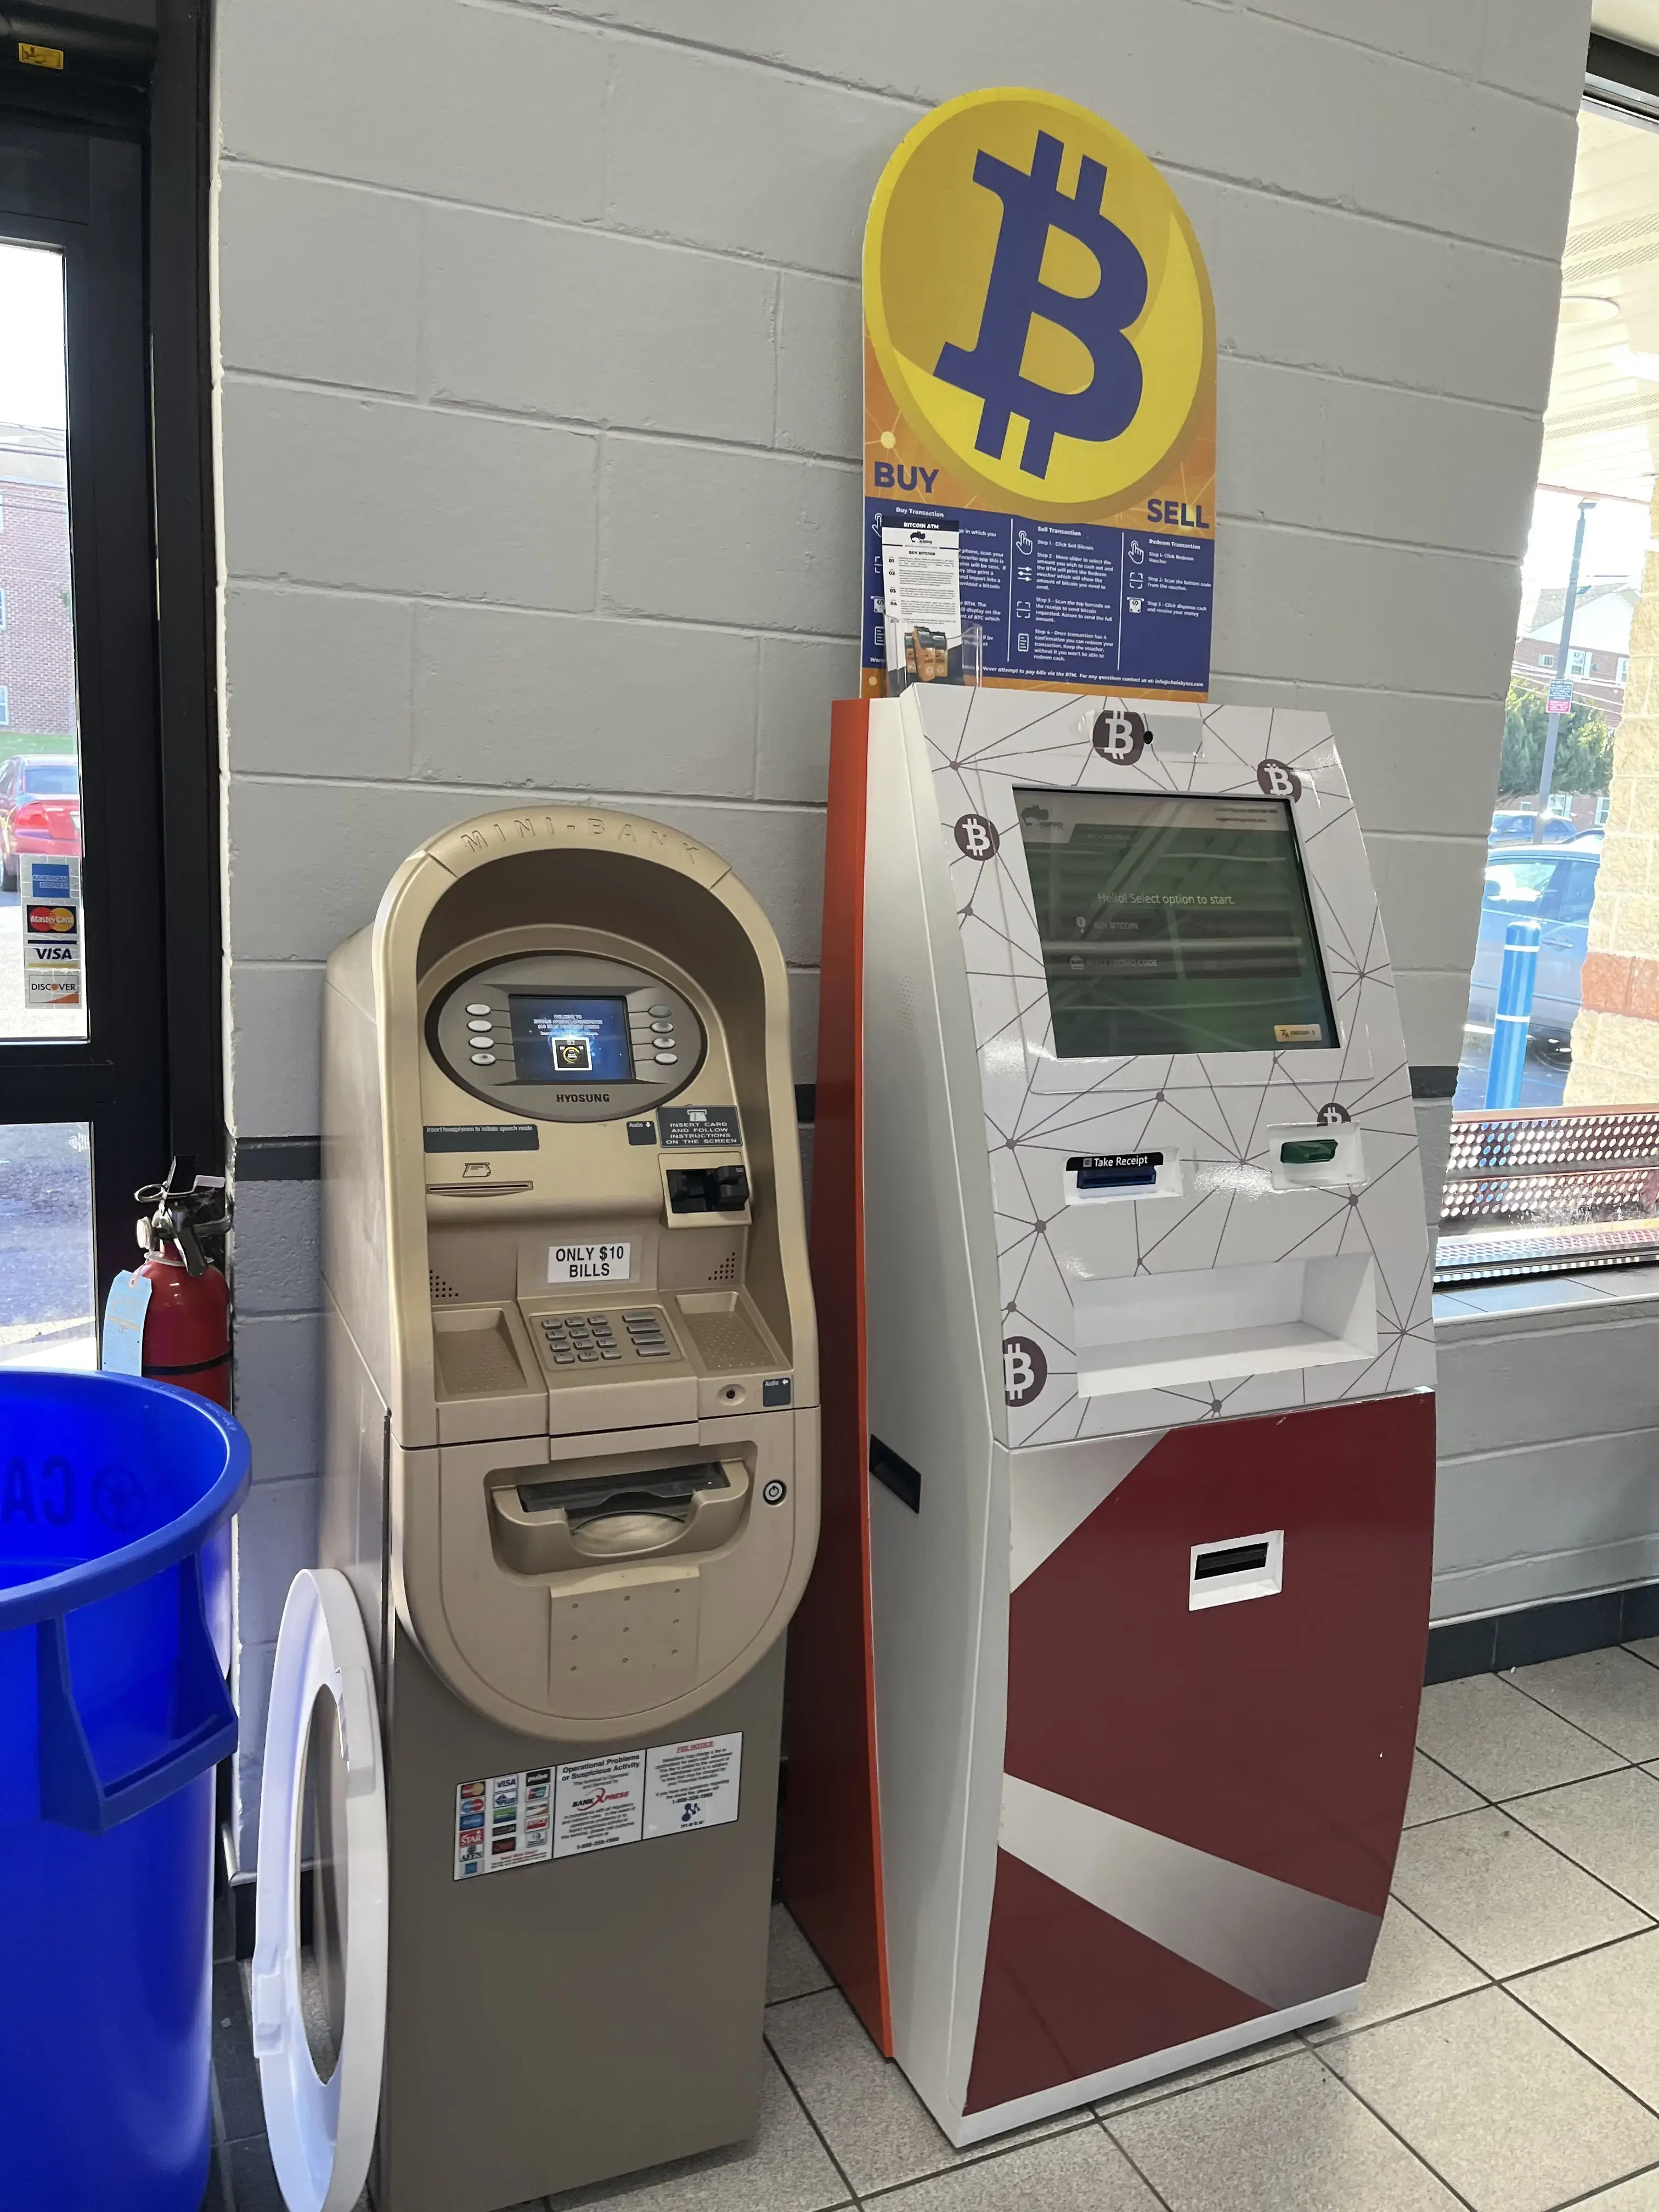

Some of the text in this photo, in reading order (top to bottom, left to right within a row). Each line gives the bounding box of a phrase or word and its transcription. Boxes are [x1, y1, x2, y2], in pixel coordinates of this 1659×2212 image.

[873, 461, 940, 494] BUY
[909, 509, 944, 517] Transaction
[1147, 498, 1210, 529] SELL
[1049, 528, 1081, 536] Transaction
[460, 817, 698, 864] MINI-BANK
[1098, 893, 1235, 906] Hello! Select option to start.
[30, 915, 74, 924] MasterCard
[33, 948, 72, 960] VISA
[556, 1094, 610, 1102] HYOSUNG
[1094, 1155, 1148, 1167] Take Receipt
[556, 1245, 624, 1262] ONLY $10
[569, 1263, 610, 1278] BILLS
[563, 1754, 640, 1773] Operational Problems
[572, 1768, 611, 1779] Suspicious
[613, 1762, 640, 1771] Activity
[497, 1779, 516, 1788] VISA
[572, 1798, 594, 1807] BANK
[461, 1834, 481, 1845] STAR
